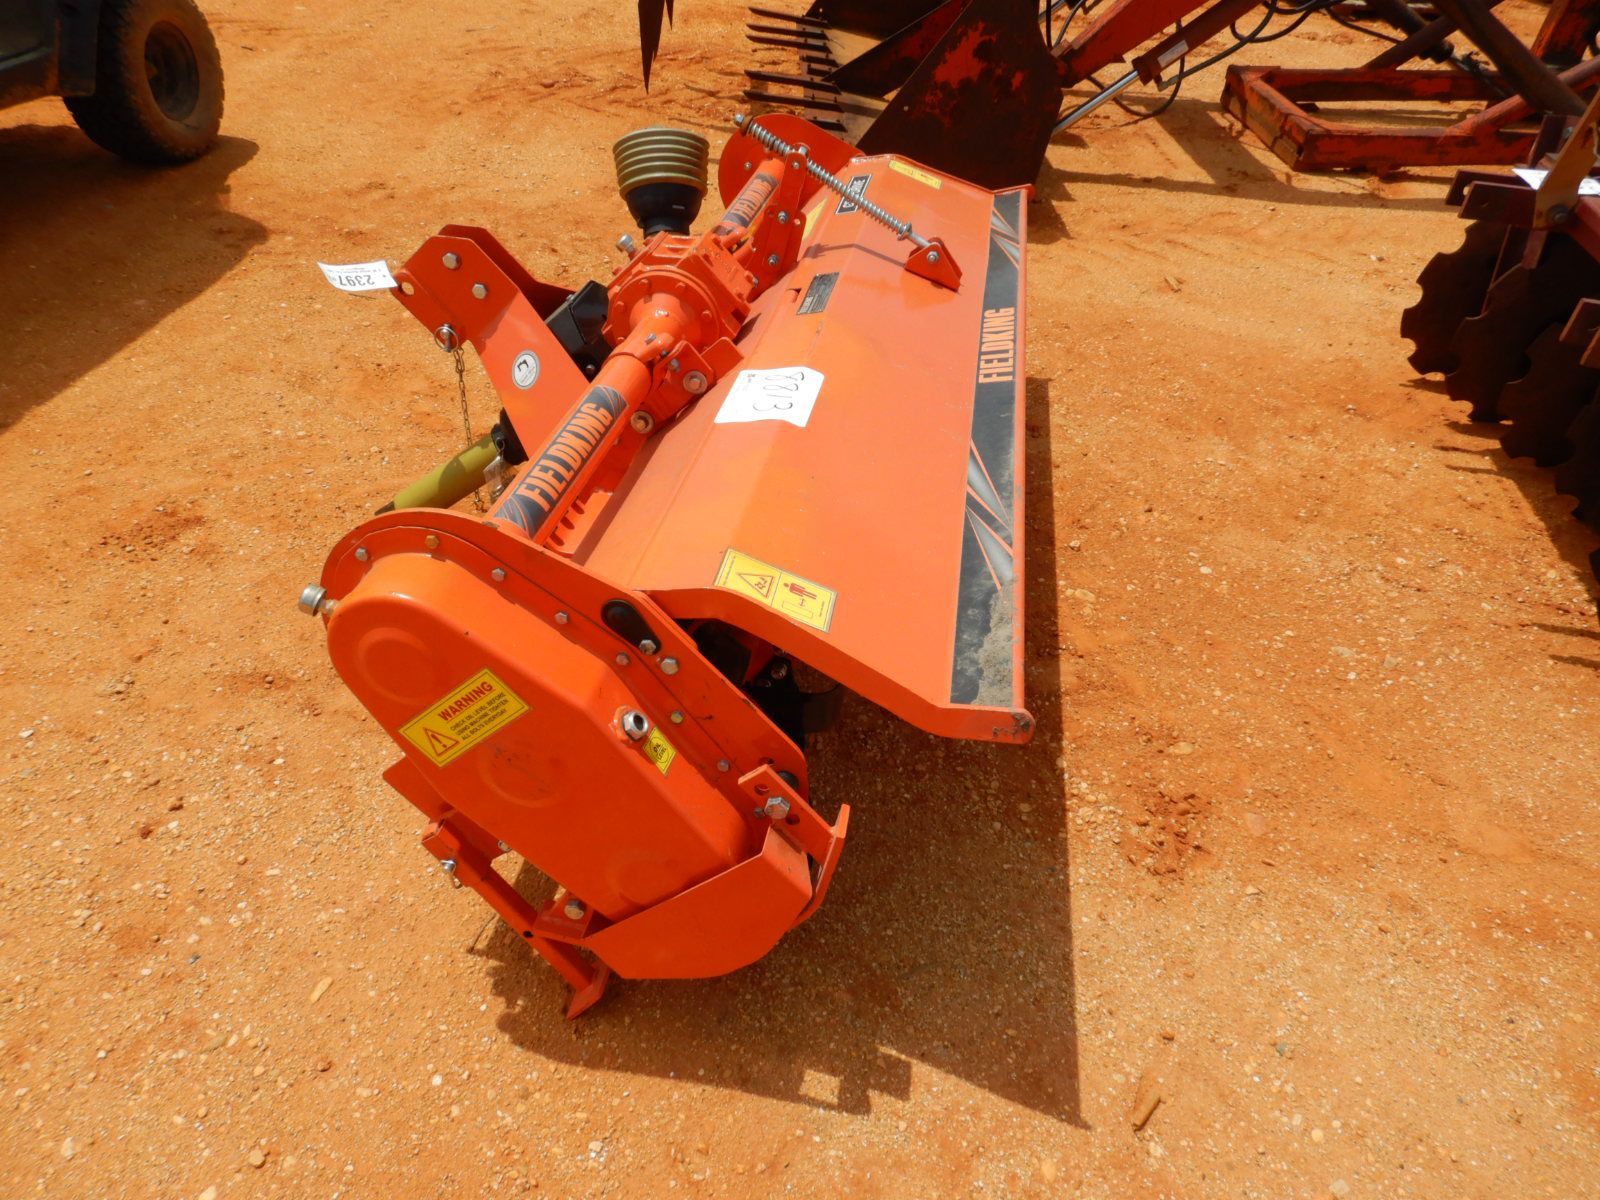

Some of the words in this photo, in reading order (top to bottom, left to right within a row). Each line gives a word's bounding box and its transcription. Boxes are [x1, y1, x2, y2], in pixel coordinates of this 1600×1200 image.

[338, 274, 375, 287] 2397
[979, 307, 1015, 383] FIELDKING
[518, 402, 613, 512] FIELDKING
[438, 680, 494, 721] WARNING
[450, 719, 465, 731] CHECK
[473, 705, 488, 716] LEVEL
[486, 691, 506, 706] BEFORE
[468, 711, 490, 726] MACHINE
[488, 698, 509, 713] TIGHTEN
[469, 723, 485, 735] BOLTS
[484, 708, 507, 726] EVERYDAY
